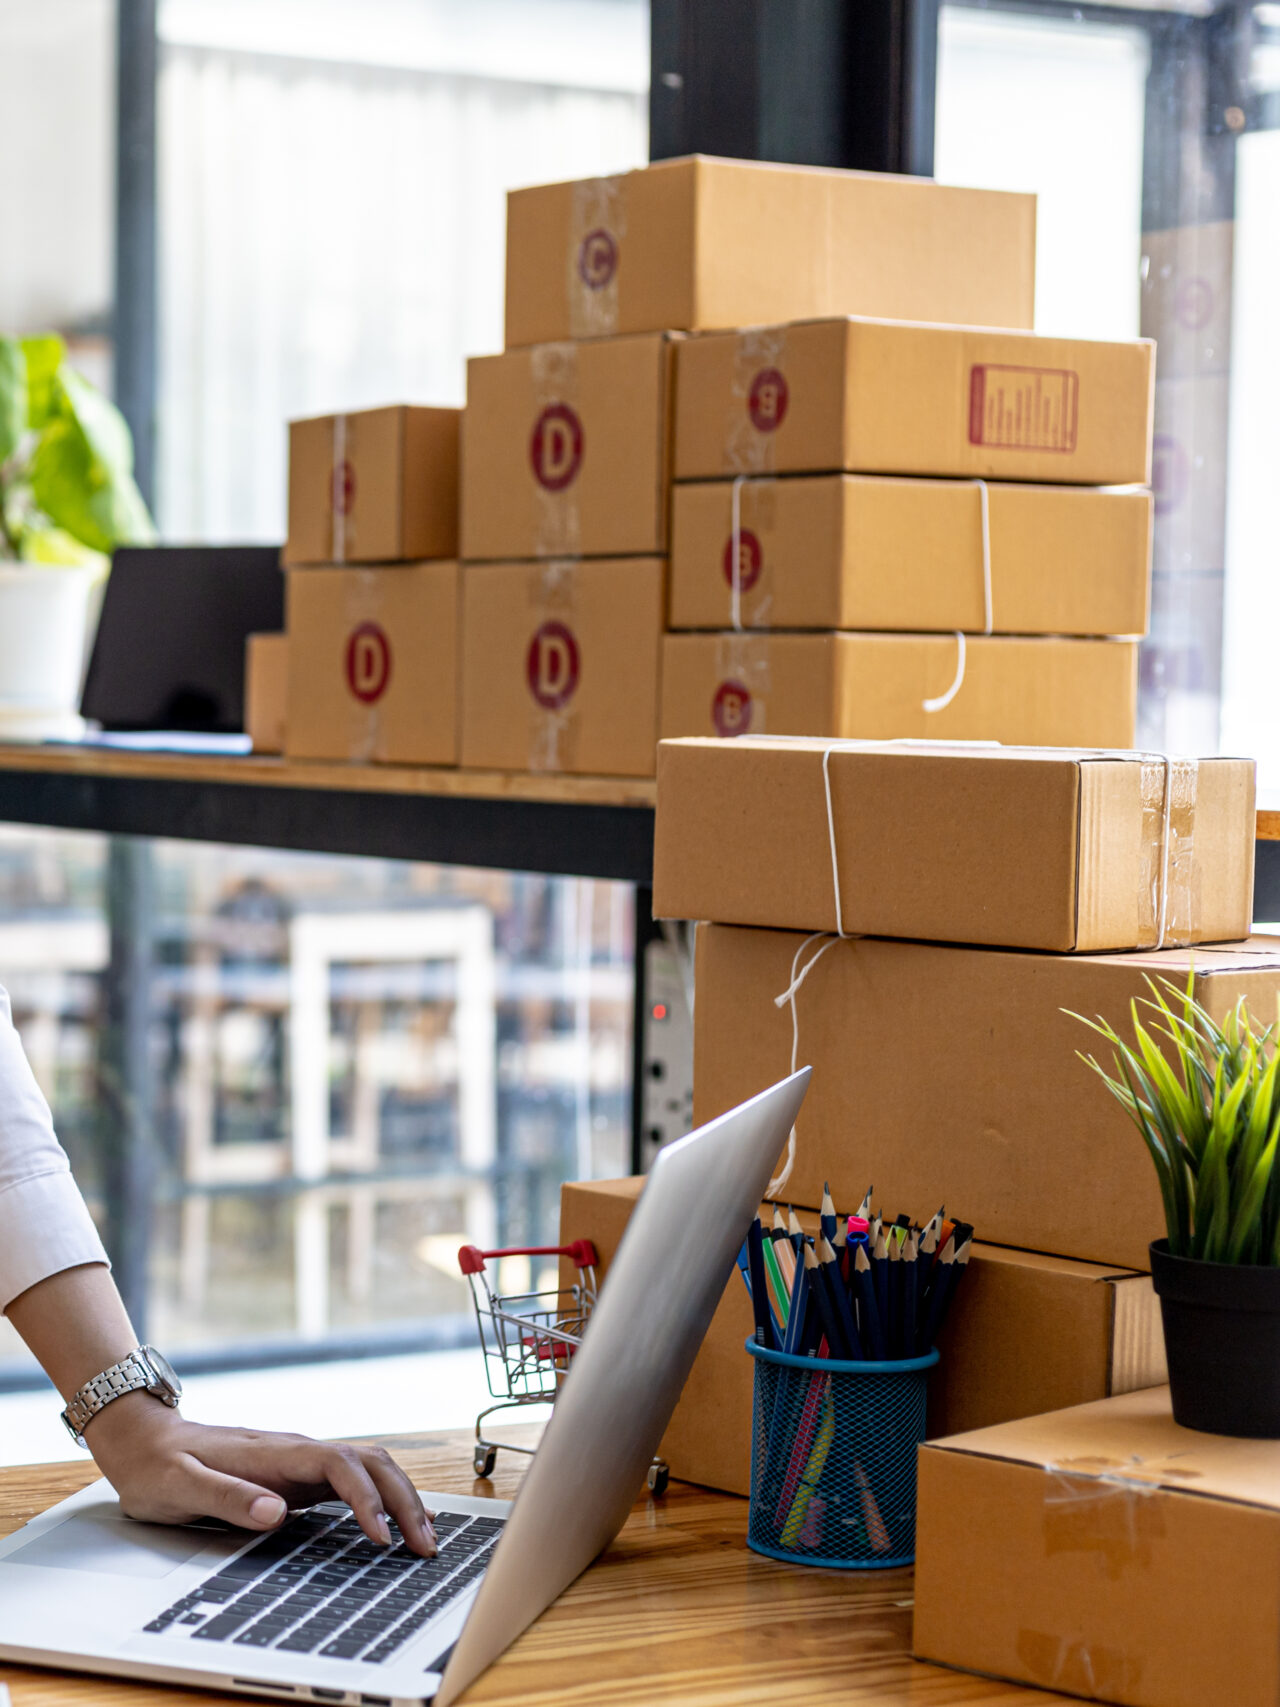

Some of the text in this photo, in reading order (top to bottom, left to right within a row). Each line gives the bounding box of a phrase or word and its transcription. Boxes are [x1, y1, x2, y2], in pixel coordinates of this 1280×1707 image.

[585, 238, 609, 281] C
[541, 417, 573, 479] D
[354, 636, 383, 692] D
[538, 637, 570, 696] D
[722, 693, 742, 728] B
